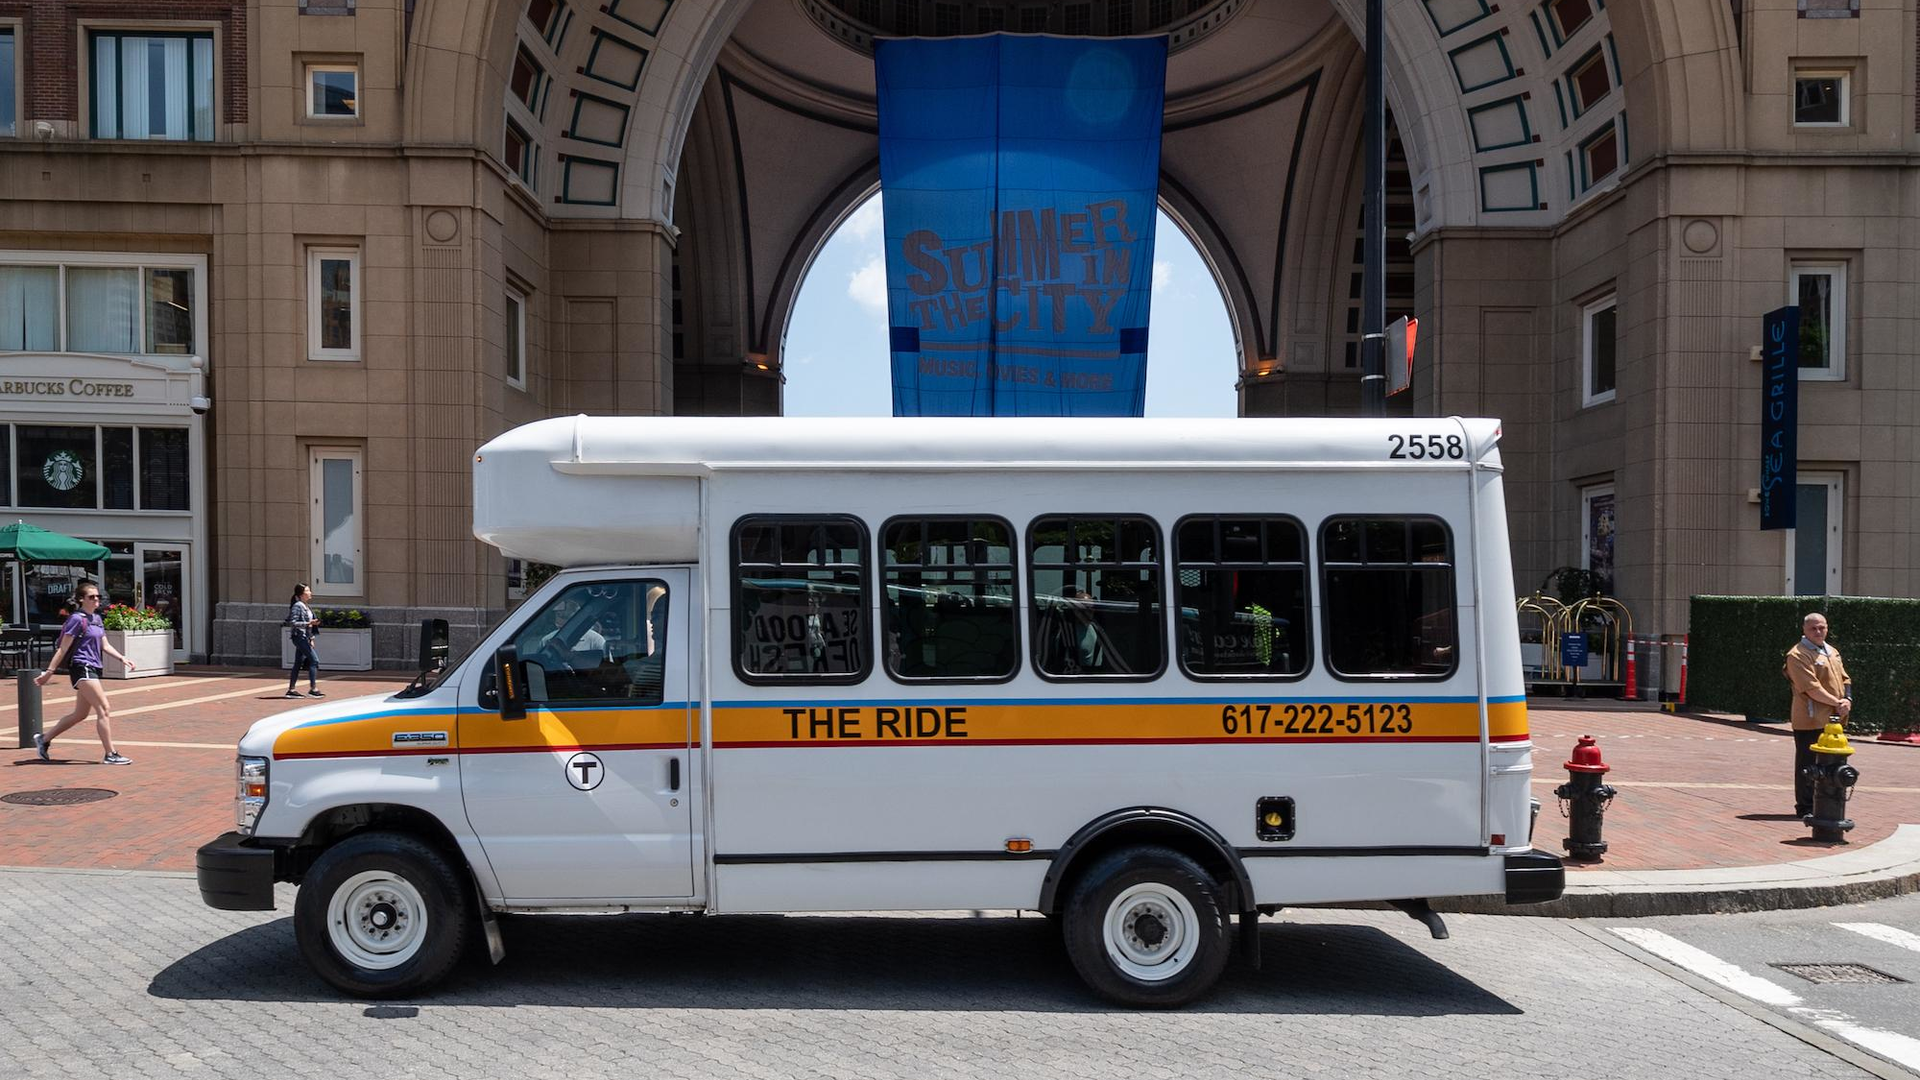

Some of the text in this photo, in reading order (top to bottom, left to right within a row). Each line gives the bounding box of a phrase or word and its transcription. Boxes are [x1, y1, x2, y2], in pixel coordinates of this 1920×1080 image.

[902, 200, 1137, 296] SUMMER
[1082, 250, 1131, 285] IN
[909, 277, 1127, 334] THE CITY
[69, 379, 134, 397] COFFEE
[986, 362, 1038, 384] OVIES
[1044, 372, 1057, 388] &
[1061, 371, 1114, 390] MORE
[1762, 320, 1785, 491] SEA GRILLE
[388, 434, 464, 459] 2558
[47, 583, 72, 595] DRAFT
[783, 707, 969, 739] THE RIDE
[1222, 704, 1413, 735] 617-222-5123
[573, 762, 597, 784] T
